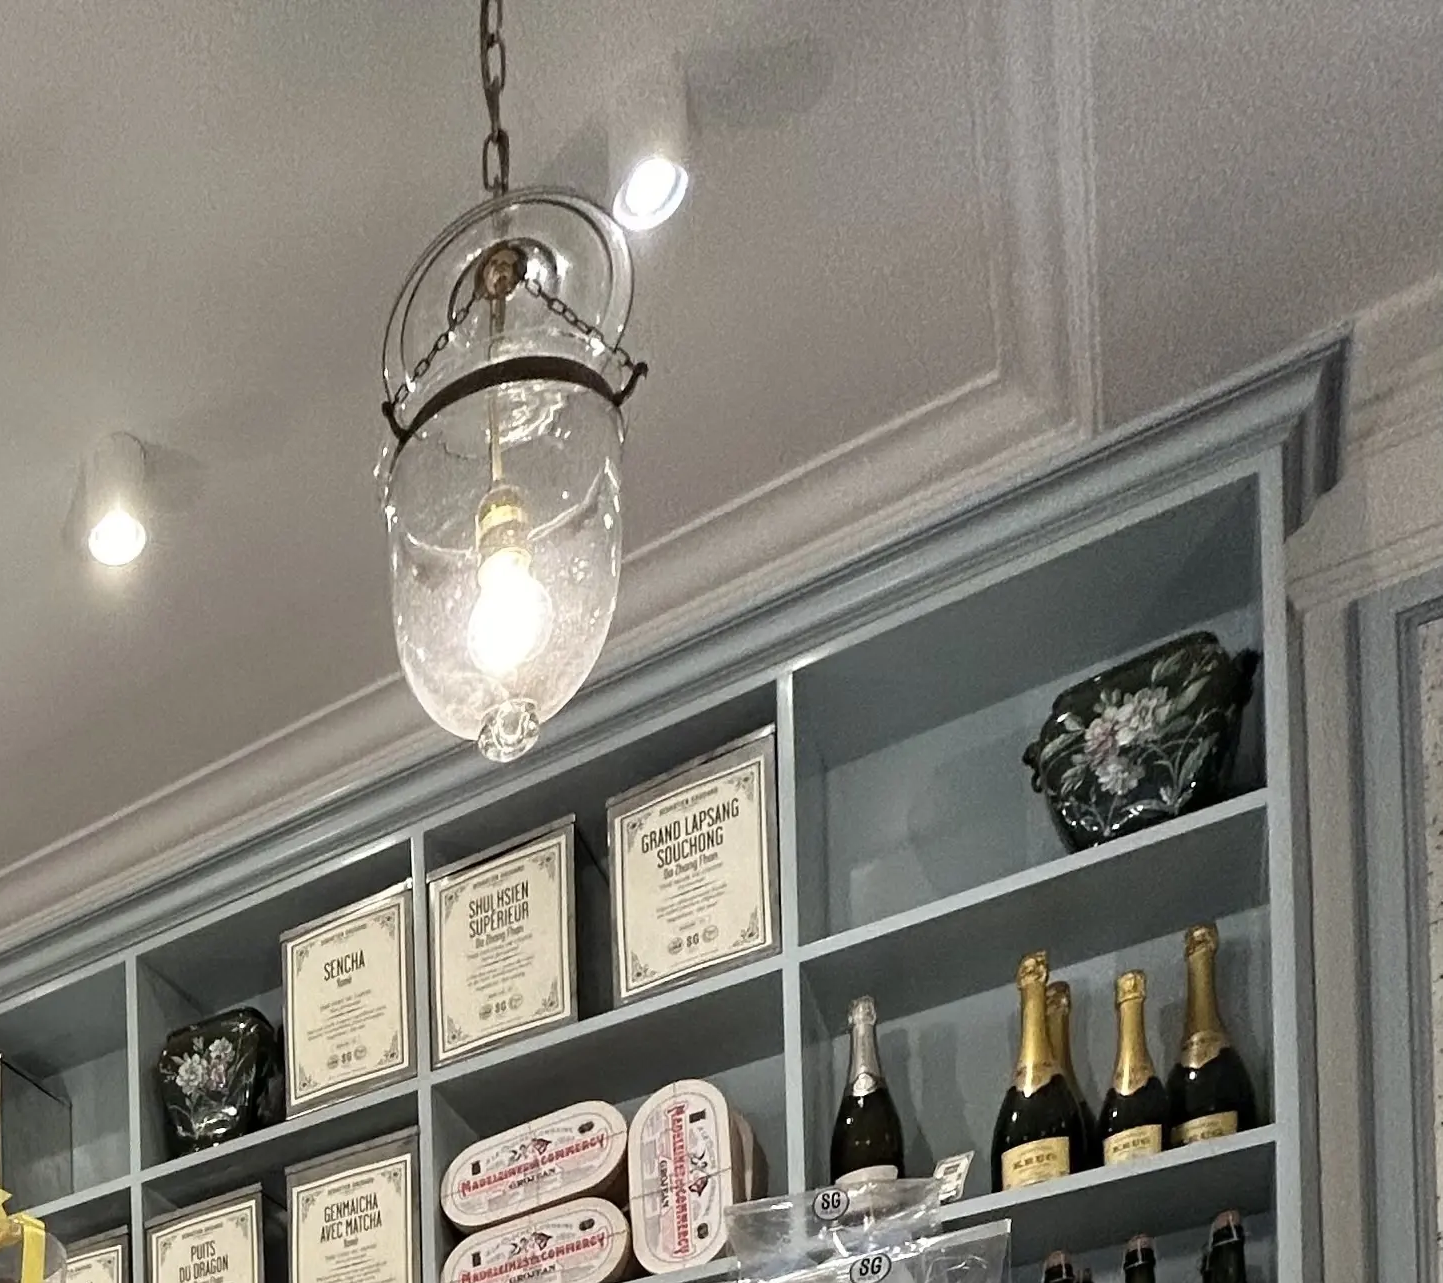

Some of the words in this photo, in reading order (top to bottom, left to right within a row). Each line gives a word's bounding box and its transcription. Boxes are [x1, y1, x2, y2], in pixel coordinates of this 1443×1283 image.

[641, 820, 681, 854] GRAND
[685, 798, 740, 836] LAPSANG
[657, 826, 724, 868] SOUCHONG
[497, 880, 529, 906] HSIEN
[469, 901, 529, 938] SUPÉRIEUR
[323, 949, 366, 981] SENCHA
[541, 1133, 605, 1166] COMMERCY
[1012, 1151, 1057, 1170] KRUG
[324, 1192, 379, 1223] GENMAICHA
[821, 1192, 841, 1210] SG
[320, 1221, 343, 1243] AVEC
[345, 1210, 383, 1237] MATCHA
[190, 1240, 216, 1263] PUITS
[541, 1231, 606, 1262] COMMERCY
[179, 1266, 191, 1283] DU
[193, 1254, 229, 1279] DRAGON
[859, 1257, 883, 1276] SG
